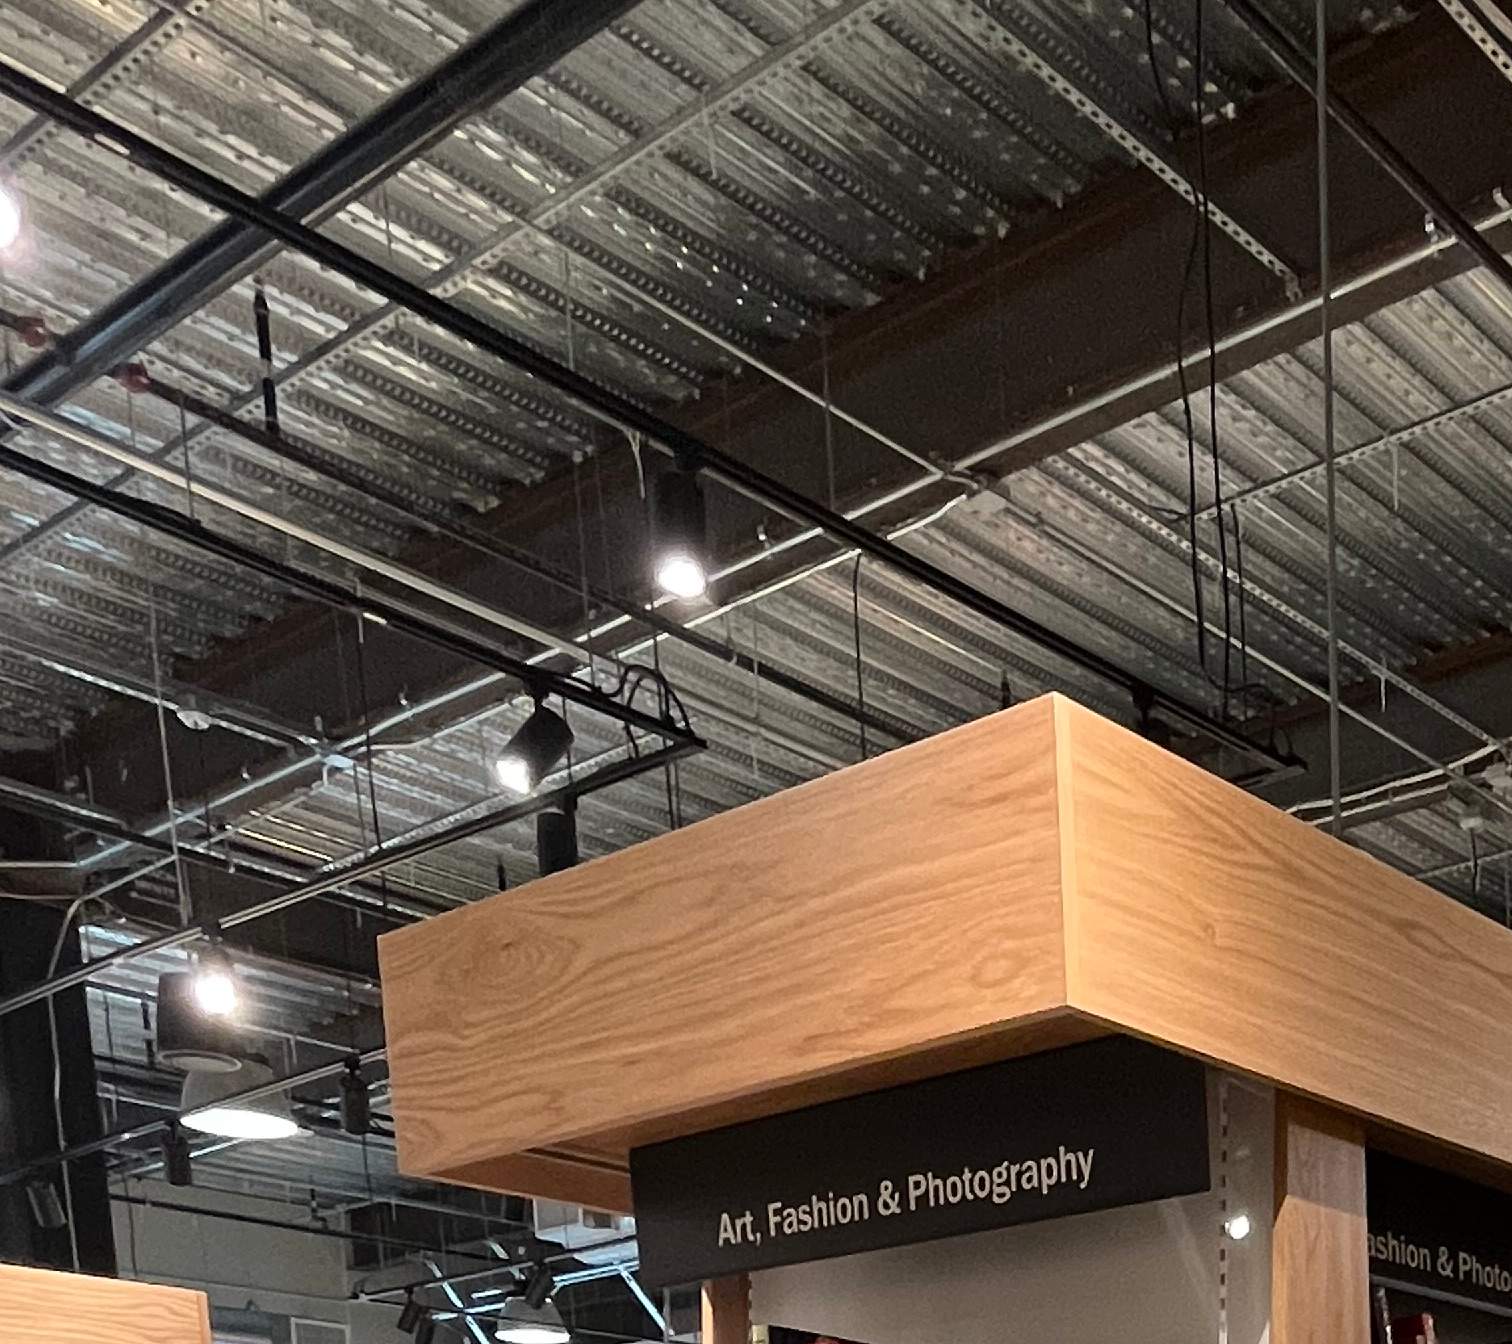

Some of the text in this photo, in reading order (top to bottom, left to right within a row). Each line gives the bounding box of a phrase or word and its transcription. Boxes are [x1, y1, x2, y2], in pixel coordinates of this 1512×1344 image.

[717, 1143, 1096, 1249] Art, Fashion & Photography
[1437, 1246, 1454, 1278] &
